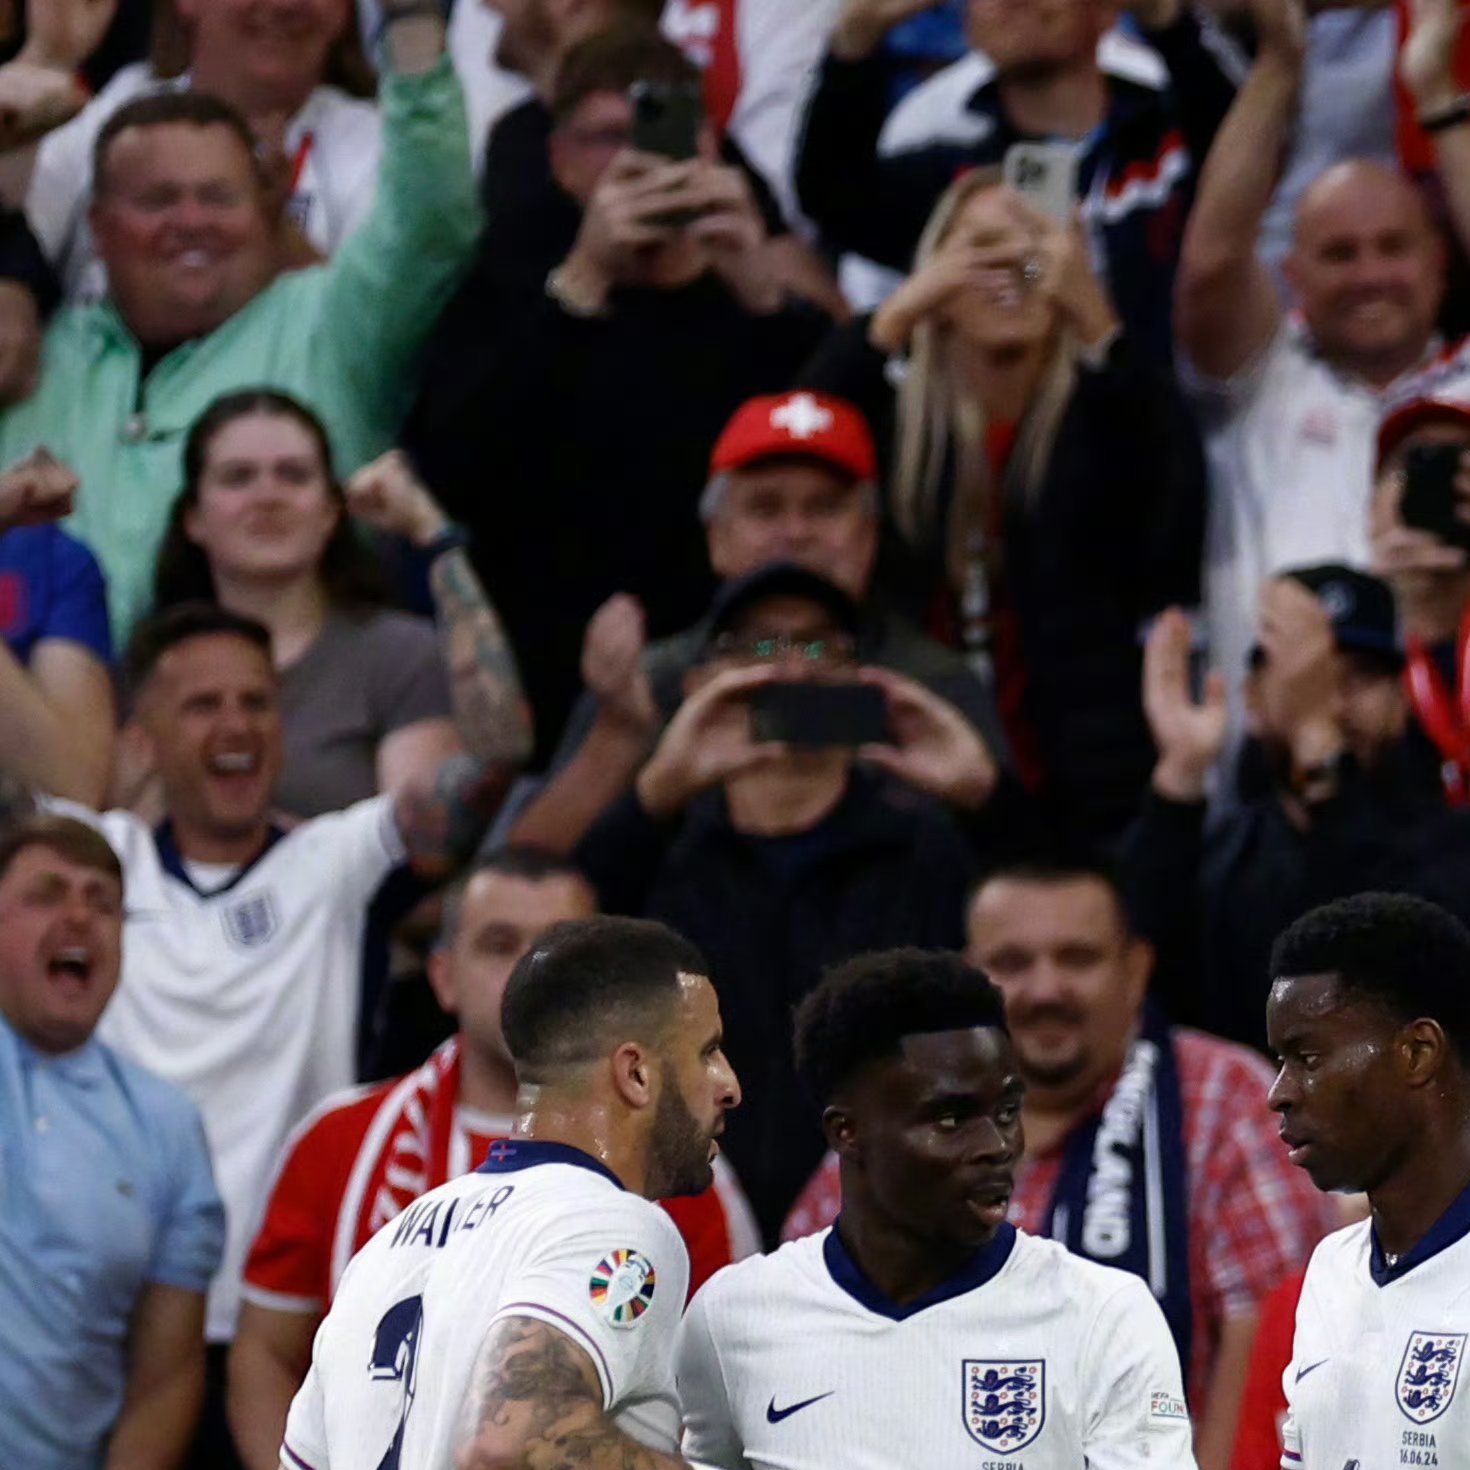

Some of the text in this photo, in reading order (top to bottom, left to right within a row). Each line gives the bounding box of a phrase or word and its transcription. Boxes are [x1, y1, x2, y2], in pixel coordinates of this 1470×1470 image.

[389, 1184, 515, 1250] WALER
[1402, 1430, 1437, 1448] SERBIA
[1400, 1449, 1439, 1467] 16.06.24
